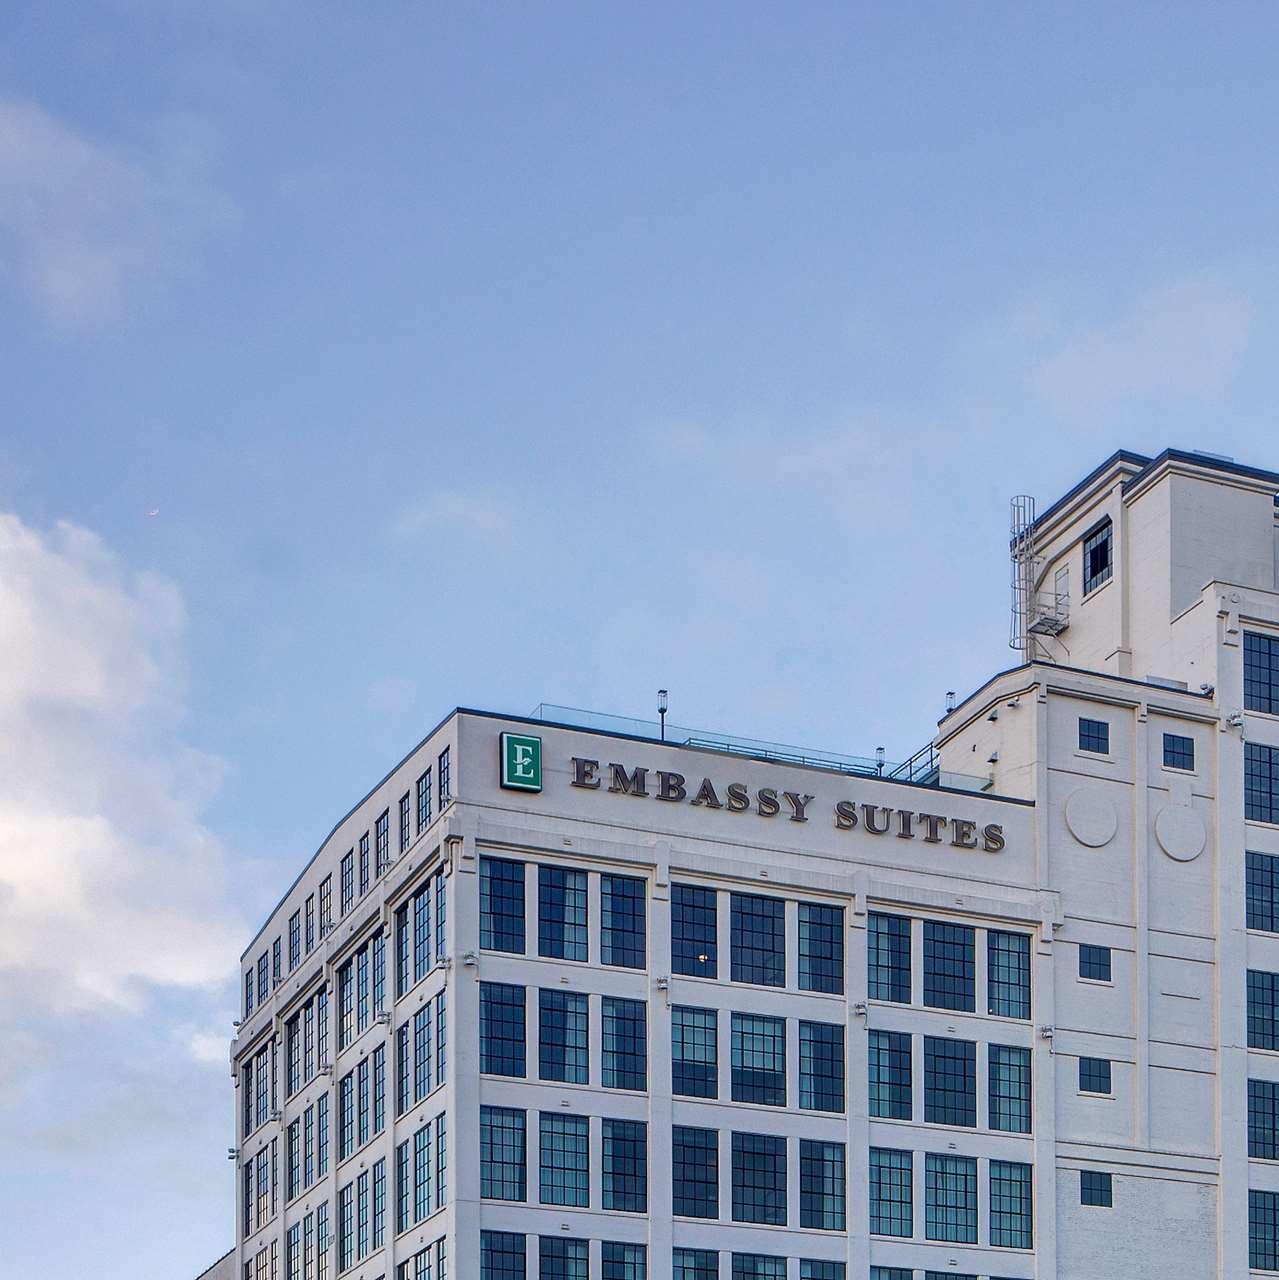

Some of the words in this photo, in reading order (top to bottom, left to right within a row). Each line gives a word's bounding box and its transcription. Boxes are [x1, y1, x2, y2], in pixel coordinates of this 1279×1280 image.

[513, 744, 534, 778] E
[571, 756, 815, 822] EMBASSY
[834, 799, 1007, 854] SUITES
